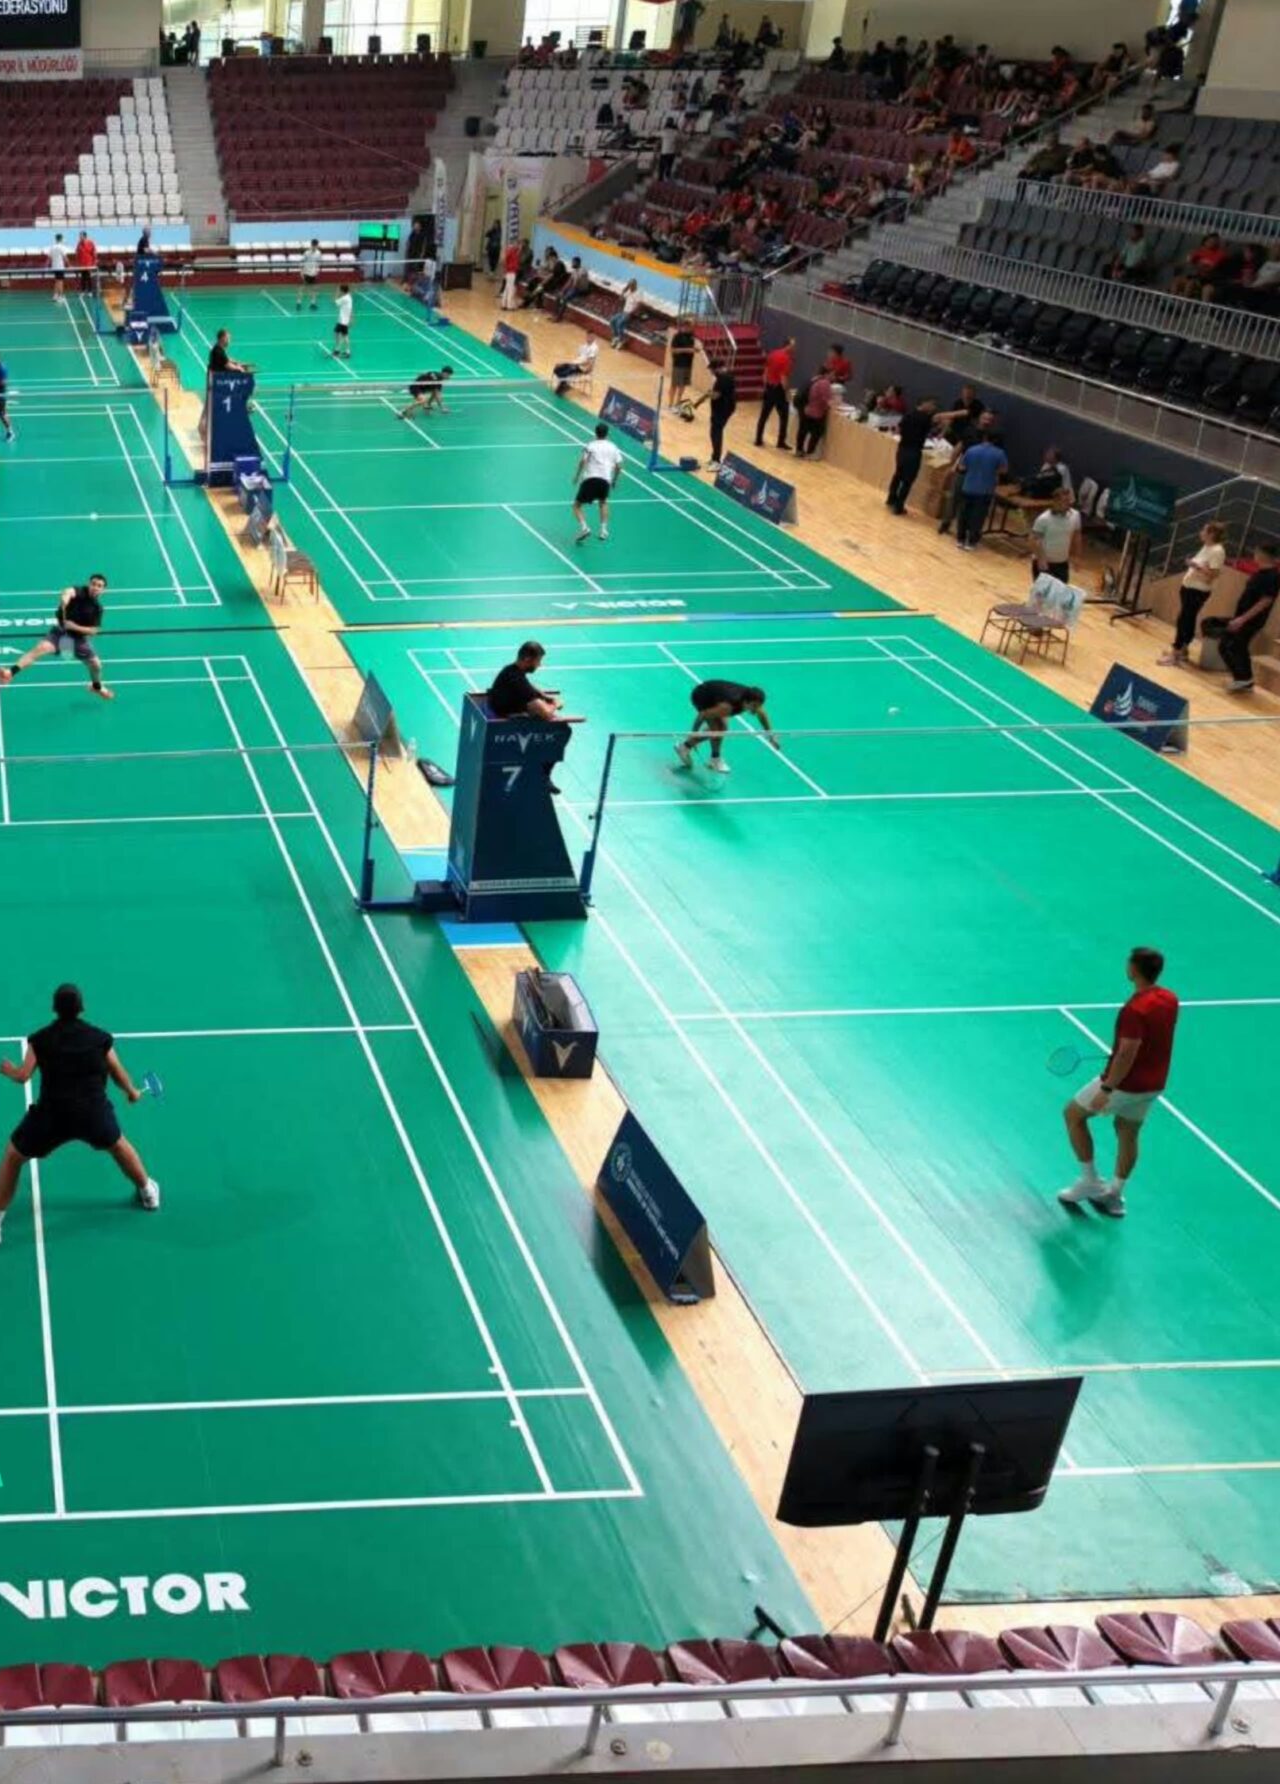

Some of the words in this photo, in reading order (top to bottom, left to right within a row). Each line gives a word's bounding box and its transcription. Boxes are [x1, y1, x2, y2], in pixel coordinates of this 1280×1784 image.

[140, 271, 149, 282] 4
[222, 396, 232, 413] 1
[494, 731, 556, 755] NAVEK
[501, 765, 522, 792] 7
